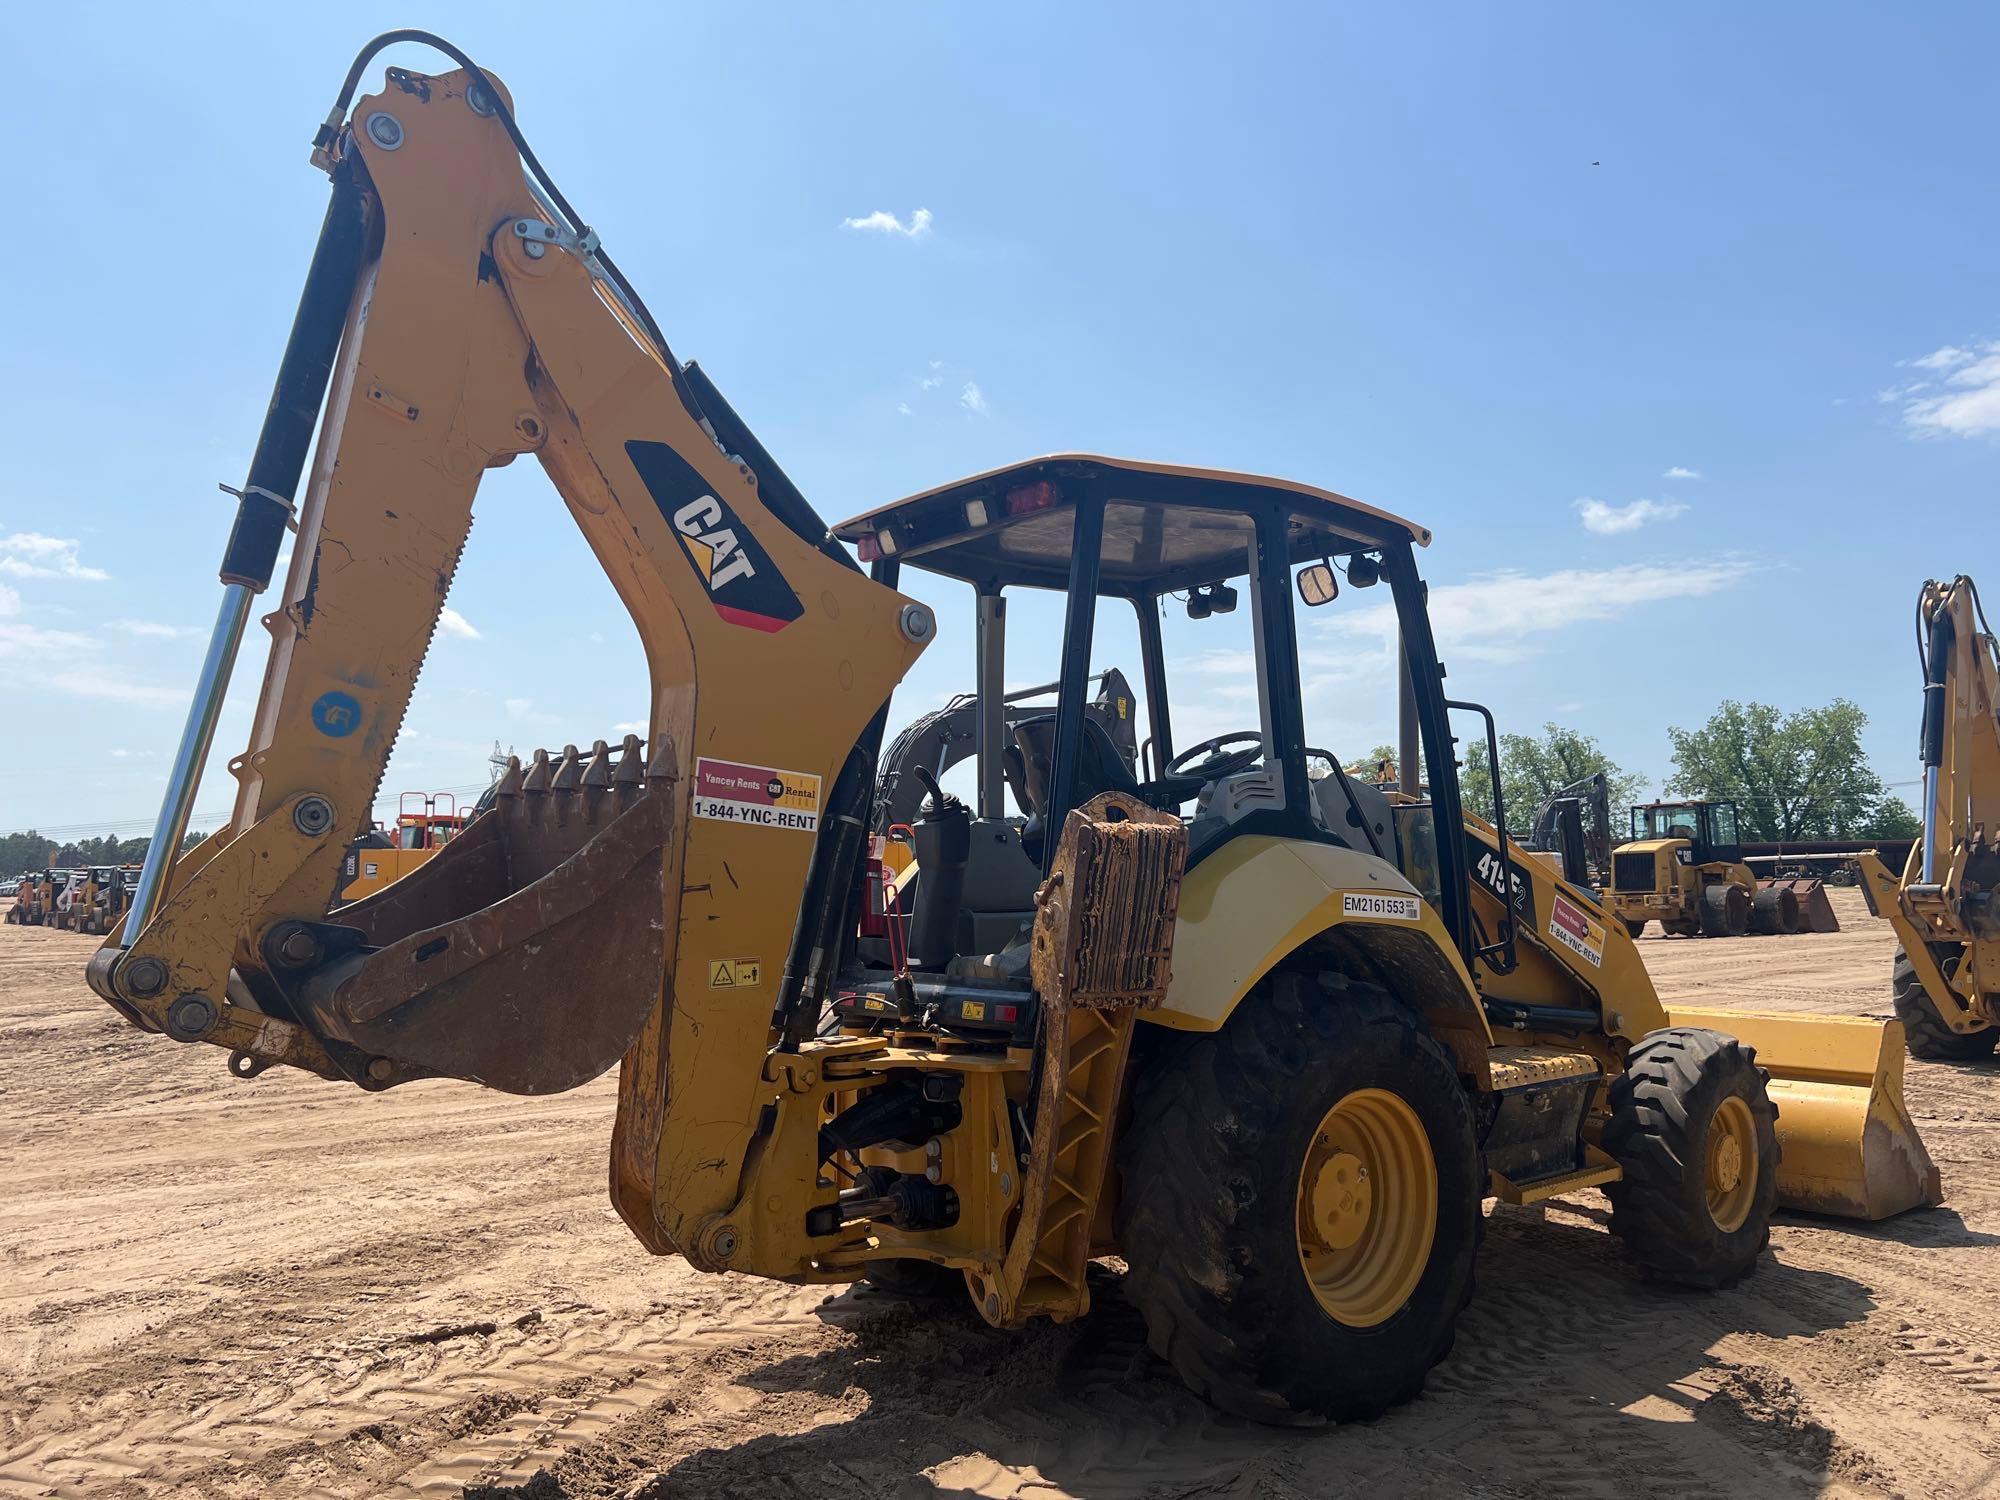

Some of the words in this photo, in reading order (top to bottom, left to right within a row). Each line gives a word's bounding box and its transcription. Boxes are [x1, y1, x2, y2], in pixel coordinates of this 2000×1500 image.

[673, 494, 756, 591] CAT
[705, 773, 736, 787] Yancey
[737, 778, 760, 790] Rents
[768, 783, 782, 794] CAT
[785, 786, 816, 799] Rental
[695, 801, 817, 830] 1-844-YNC-RENT
[1344, 896, 1405, 914] EM2161553
[1550, 924, 1601, 966] 1-844-YNC-RENT
